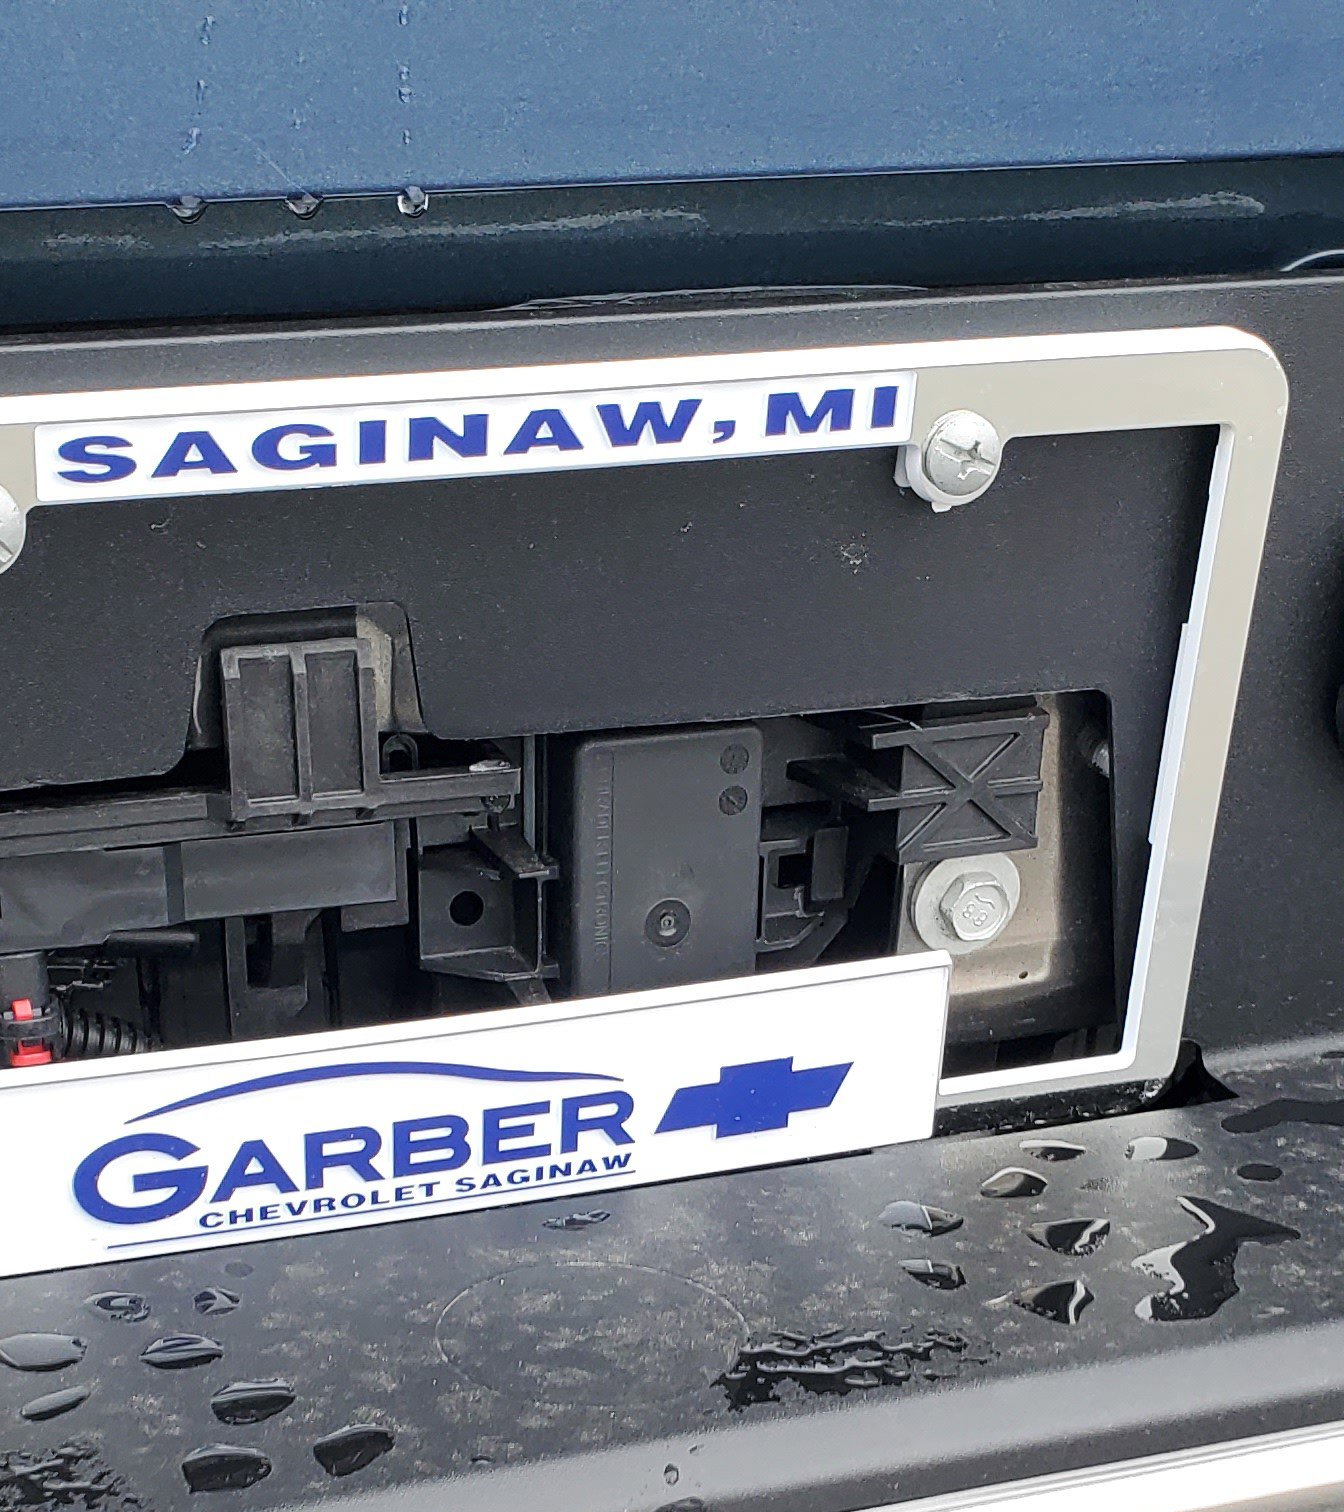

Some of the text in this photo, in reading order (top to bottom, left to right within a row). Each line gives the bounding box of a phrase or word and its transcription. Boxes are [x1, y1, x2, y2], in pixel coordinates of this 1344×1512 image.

[56, 384, 899, 482] SAGINAW, MI
[72, 1089, 634, 1226] GARBER
[197, 1153, 634, 1230] CHEVROLET SAGINAW
